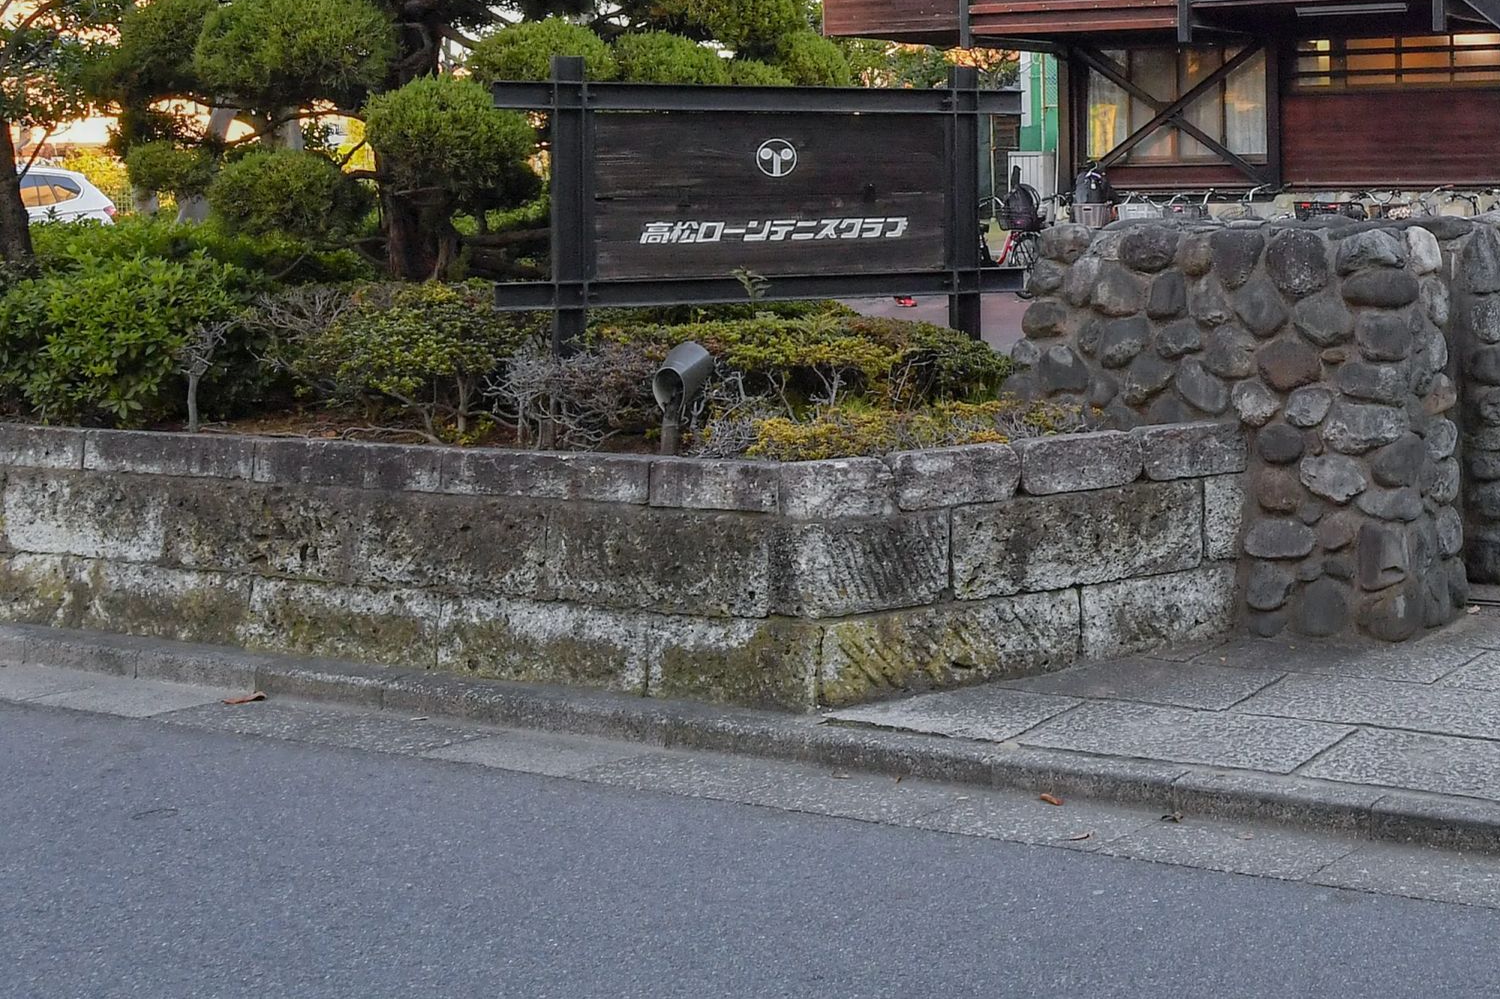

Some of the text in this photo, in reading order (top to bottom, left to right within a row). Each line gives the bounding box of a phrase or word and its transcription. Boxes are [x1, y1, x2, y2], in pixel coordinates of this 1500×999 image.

[639, 216, 909, 244] 高松ローンテニスクラブ
